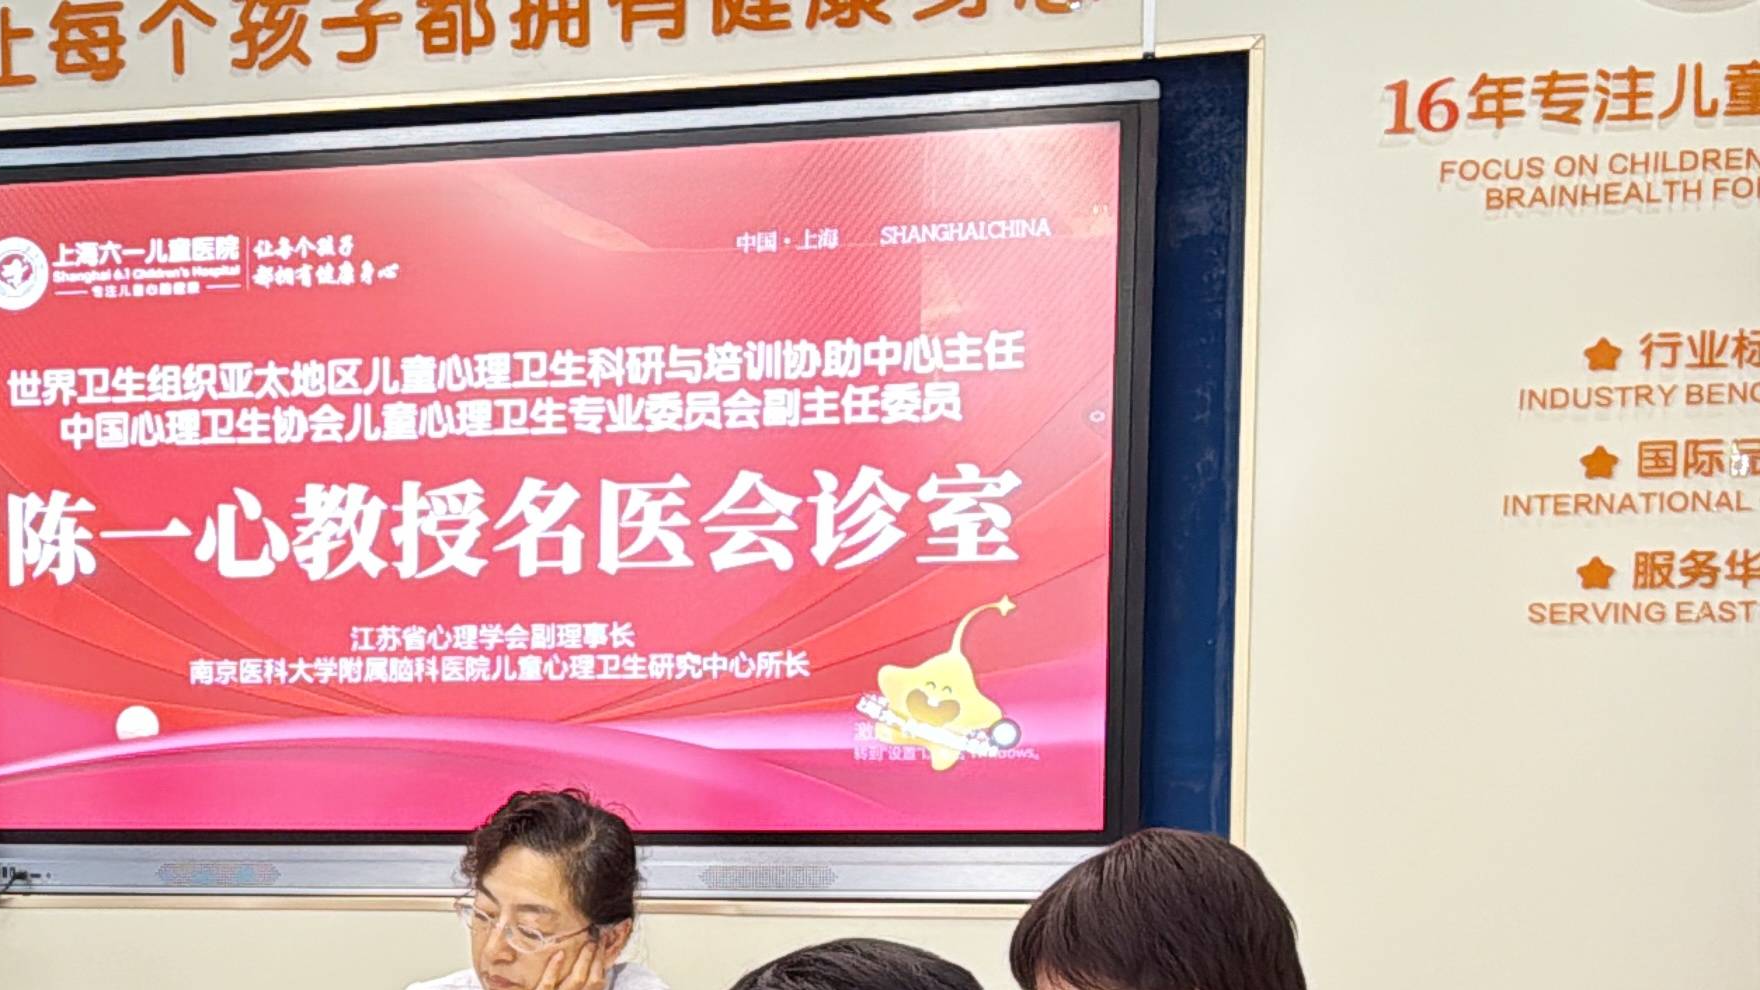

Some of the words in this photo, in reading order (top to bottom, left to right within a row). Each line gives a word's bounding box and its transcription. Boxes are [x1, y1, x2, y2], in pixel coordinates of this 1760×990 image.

[1440, 157, 1545, 184] FOCUS
[1554, 154, 1598, 177] ON
[1486, 181, 1702, 211] BRAINHEALTH
[1713, 176, 1760, 201] FO
[51, 234, 240, 267] 上海六一儿童医院
[7, 330, 1025, 407] 世界卫生组织亚太地区儿童心理卫生科研与培训协助中心主任
[1519, 383, 1678, 411] INDUSTRY
[60, 381, 963, 450] 中国心理卫生协会儿童心理卫生专业委员会副主任委员
[1503, 489, 1753, 517] INTERNATIONAL
[7, 463, 1024, 587] 陈一心教授名医会诊室
[1528, 602, 1667, 625] SERVING
[350, 621, 636, 652] 江苏省心理学会副理事长
[189, 649, 811, 686] 南京医科大学附属脑科医院儿童心理卫生研究中心所长
